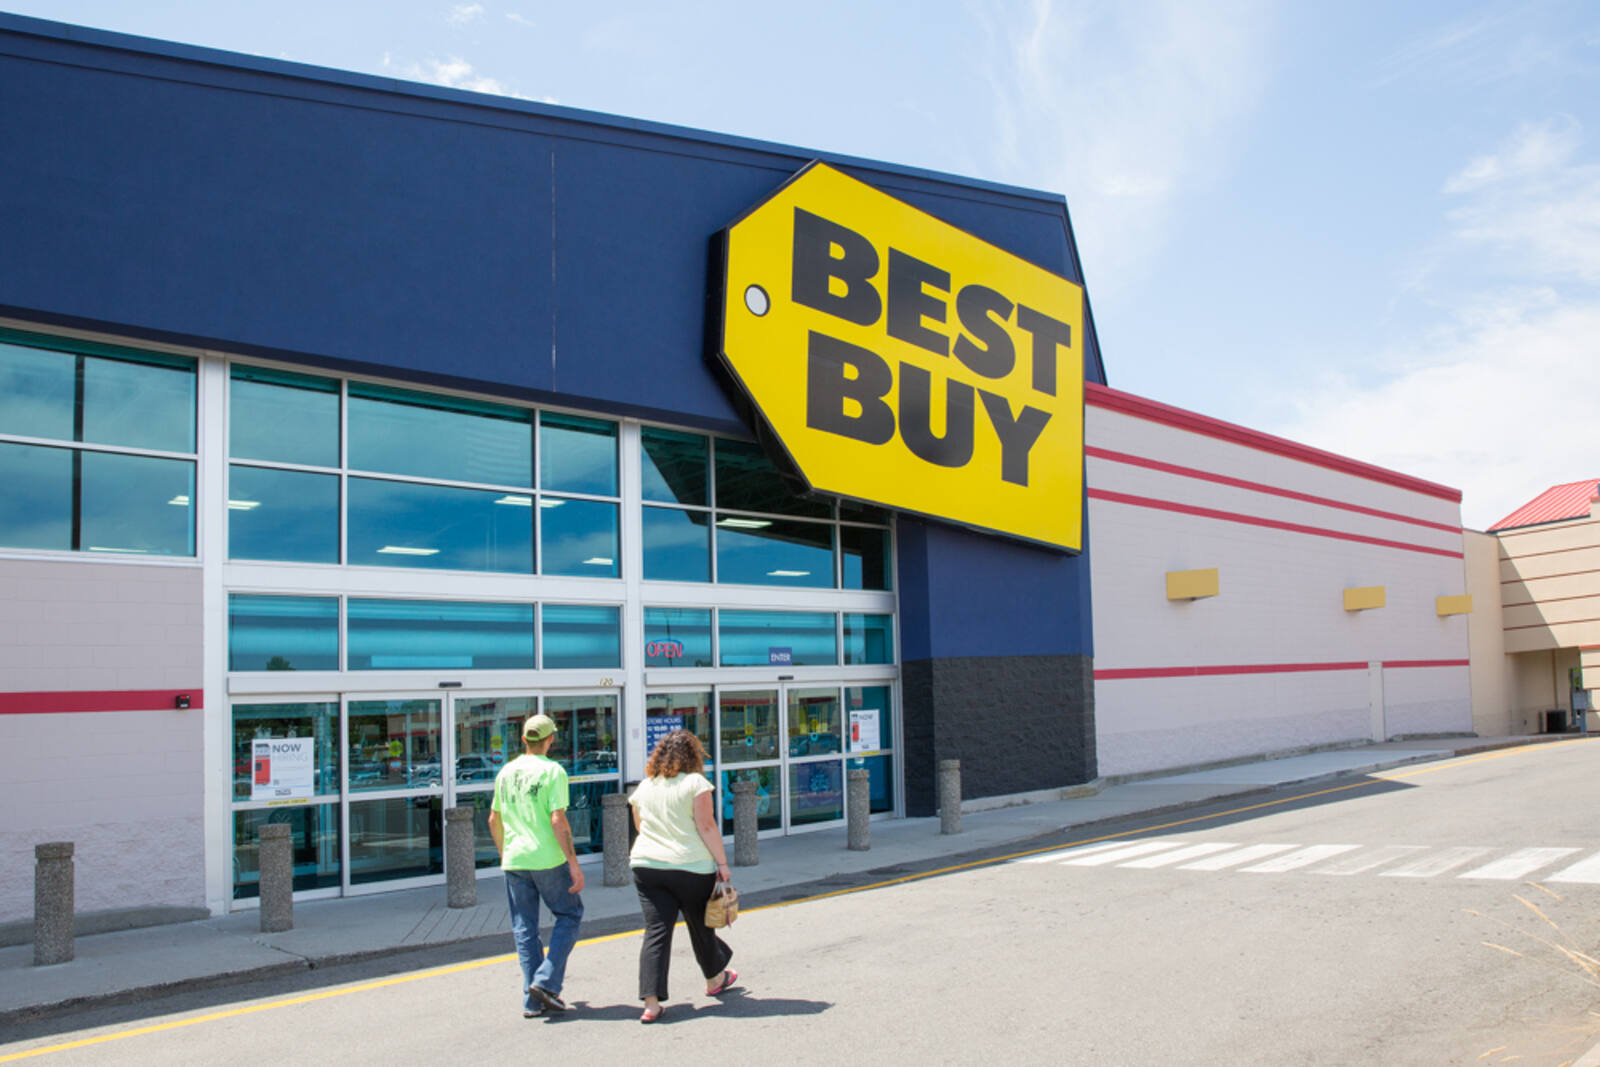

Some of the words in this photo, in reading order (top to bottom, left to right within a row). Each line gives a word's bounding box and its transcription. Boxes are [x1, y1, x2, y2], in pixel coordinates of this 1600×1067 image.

[791, 205, 1071, 397] BEST
[806, 329, 1053, 488] BUY
[647, 642, 682, 658] OPEN
[770, 653, 791, 662] ENTER
[272, 743, 302, 752] NOW
